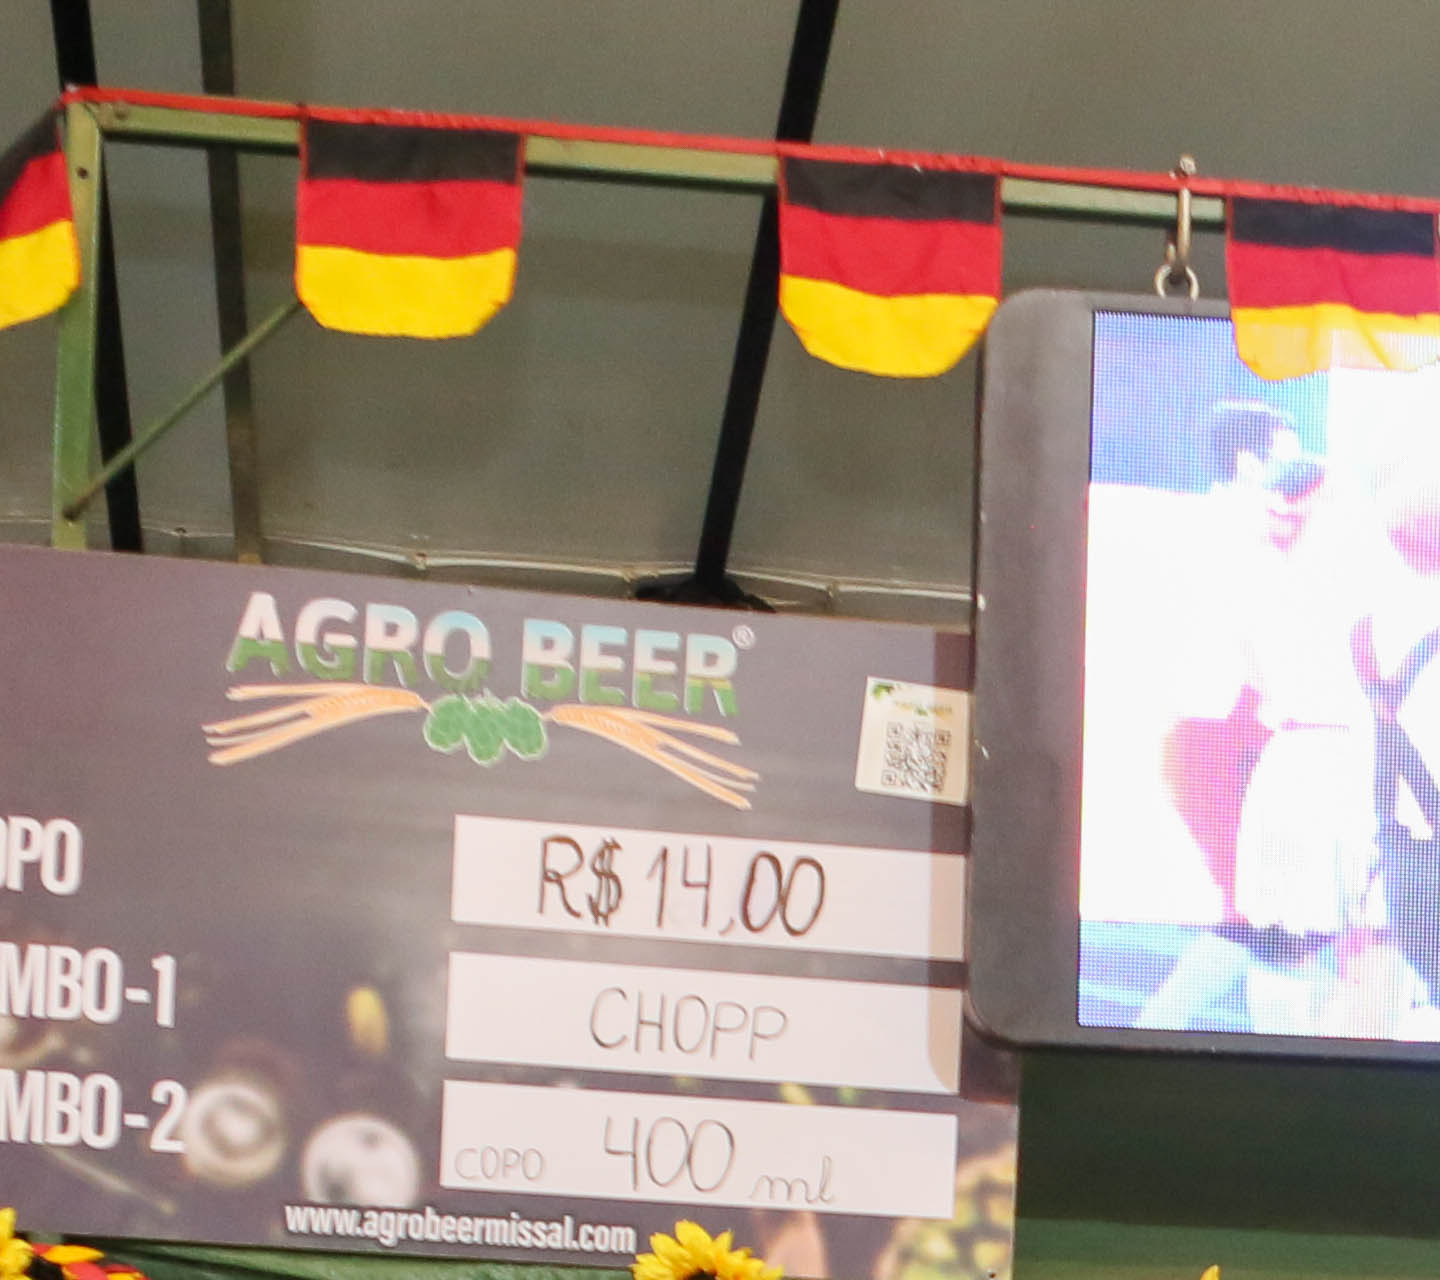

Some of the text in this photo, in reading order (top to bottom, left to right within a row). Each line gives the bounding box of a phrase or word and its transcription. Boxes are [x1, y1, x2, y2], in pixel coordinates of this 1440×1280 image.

[225, 591, 490, 692] AGRO
[536, 834, 826, 938] R$ 14,00
[588, 986, 789, 1061] CHOPP
[454, 1114, 836, 1206] COPO 400 ml
[284, 1204, 637, 1255] www.agrobeermissal.com
